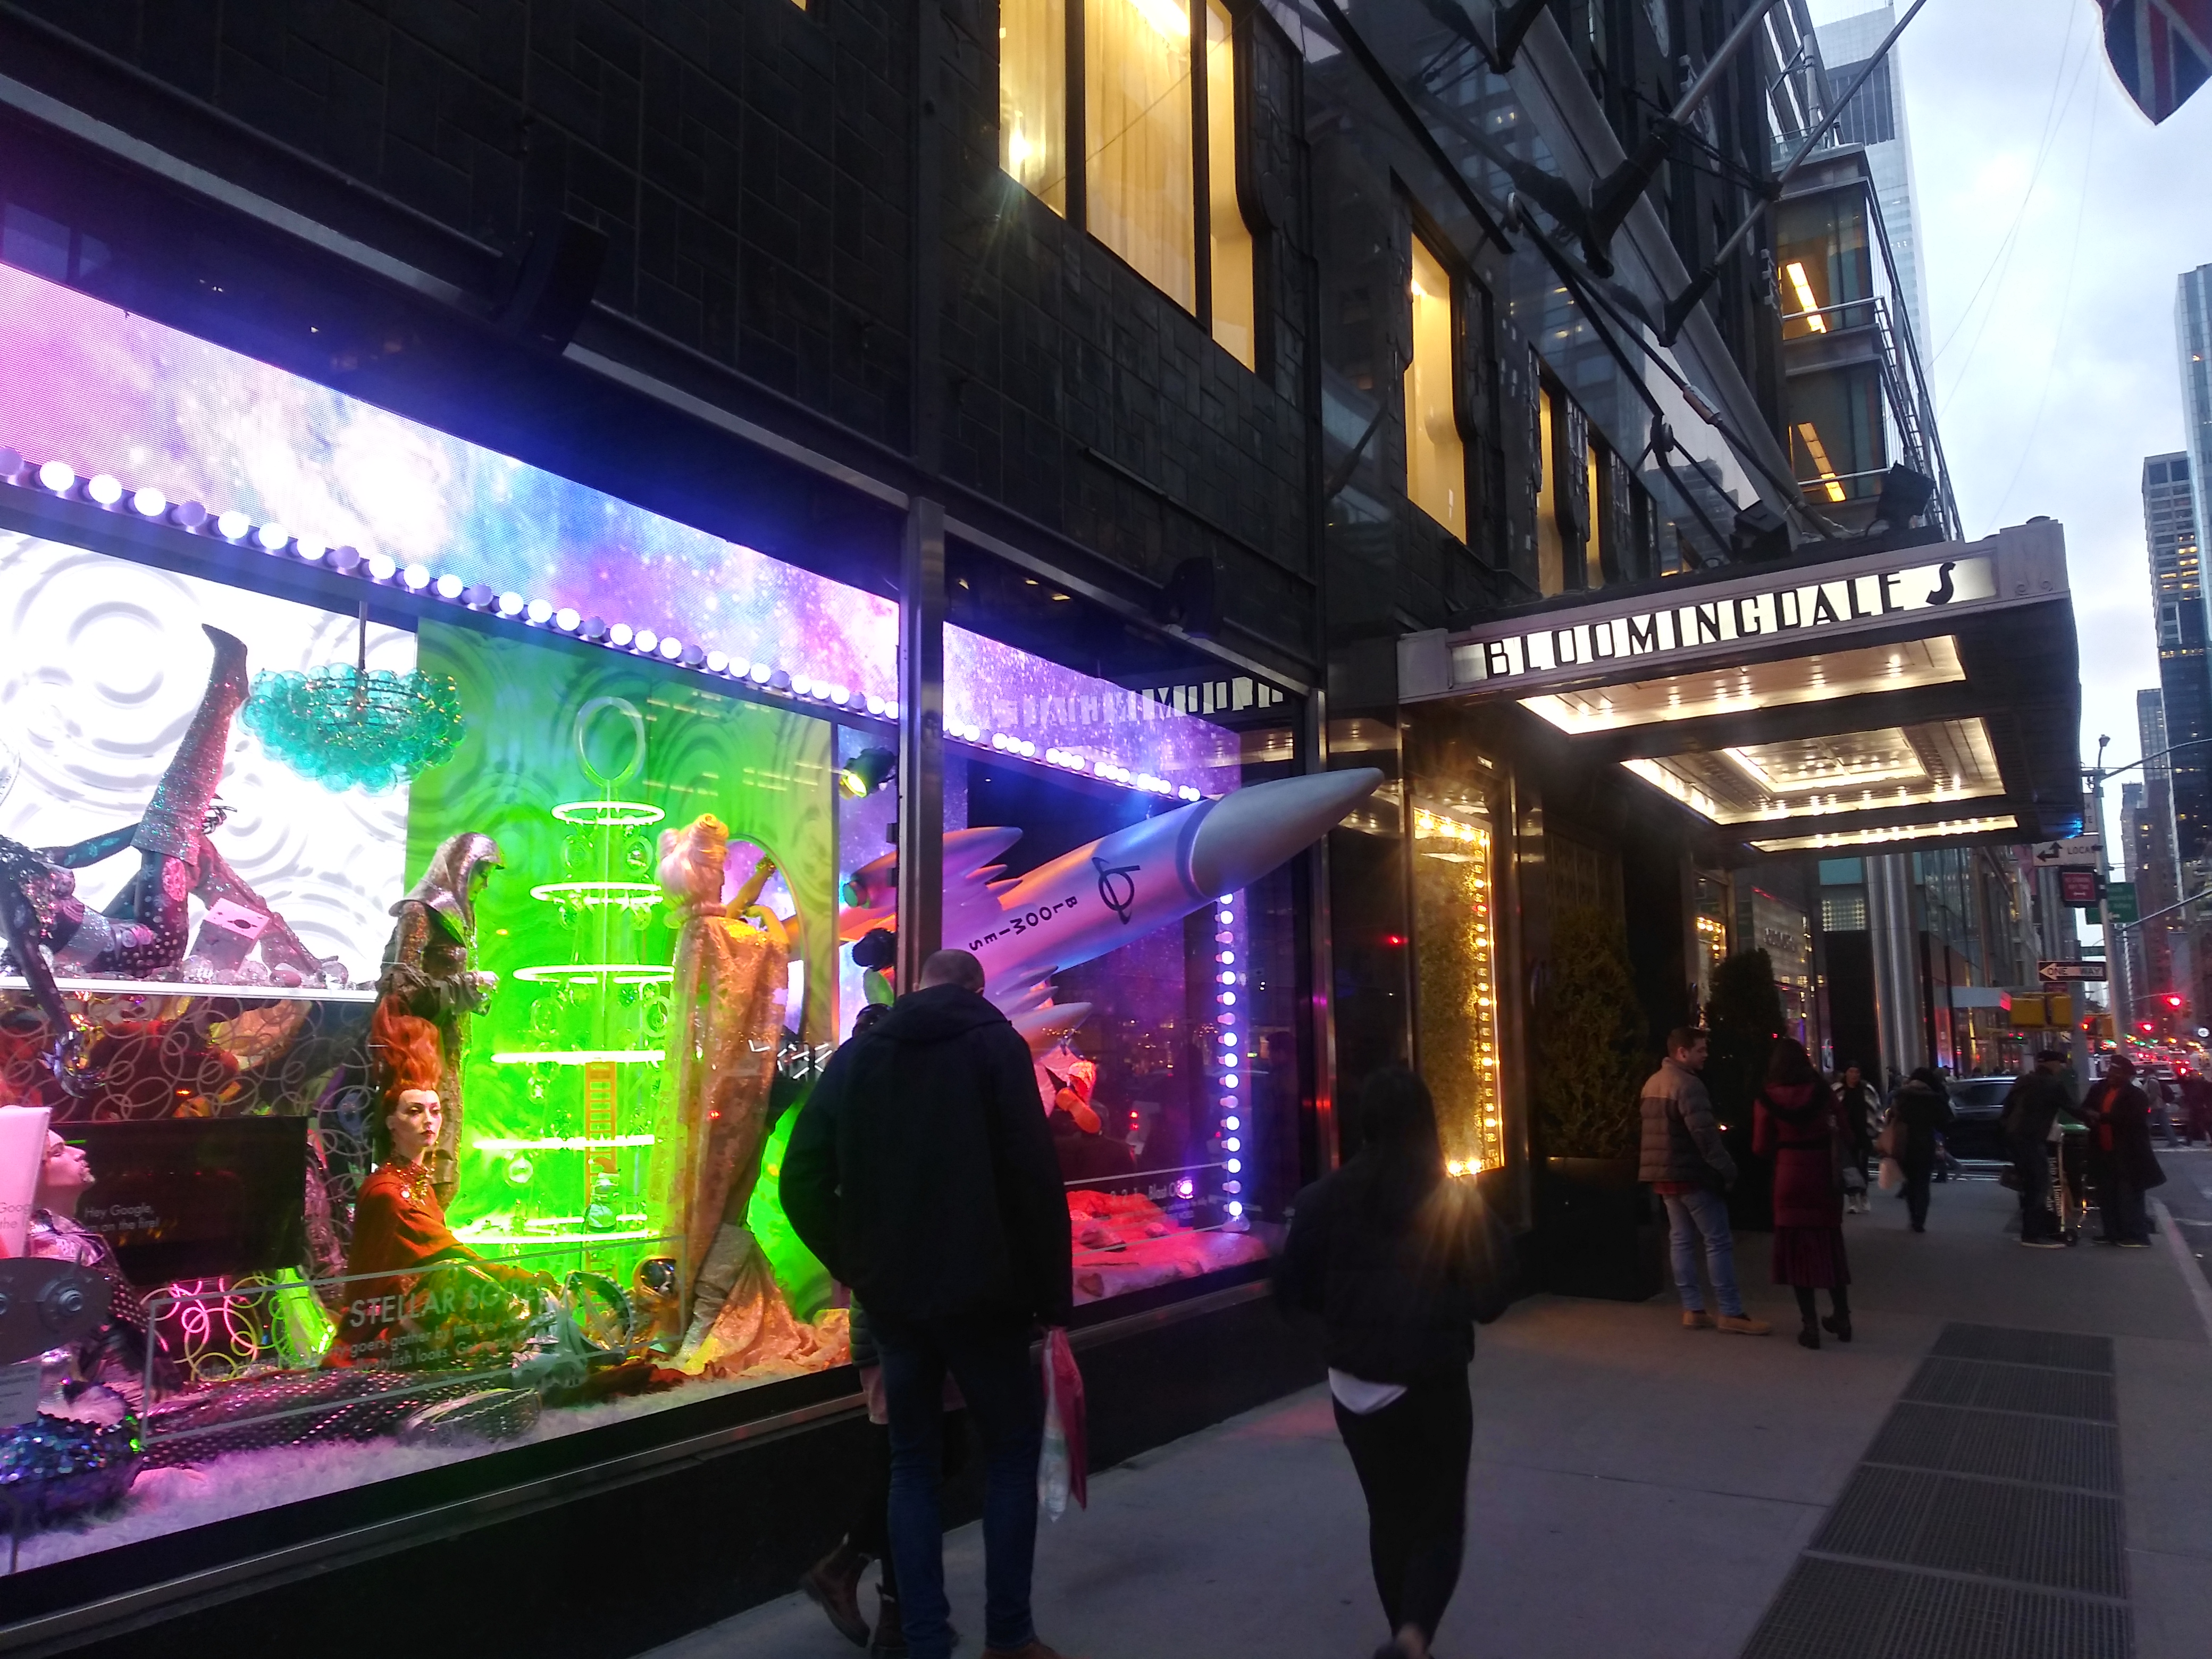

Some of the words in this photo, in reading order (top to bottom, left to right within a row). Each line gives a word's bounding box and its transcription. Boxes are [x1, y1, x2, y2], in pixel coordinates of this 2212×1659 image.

[969, 896, 1077, 951] BLOOMIES
[85, 1206, 106, 1219] Hey
[350, 1287, 455, 1327] STELLAR
[351, 1340, 387, 1358] goers
[390, 1331, 432, 1351] gather
